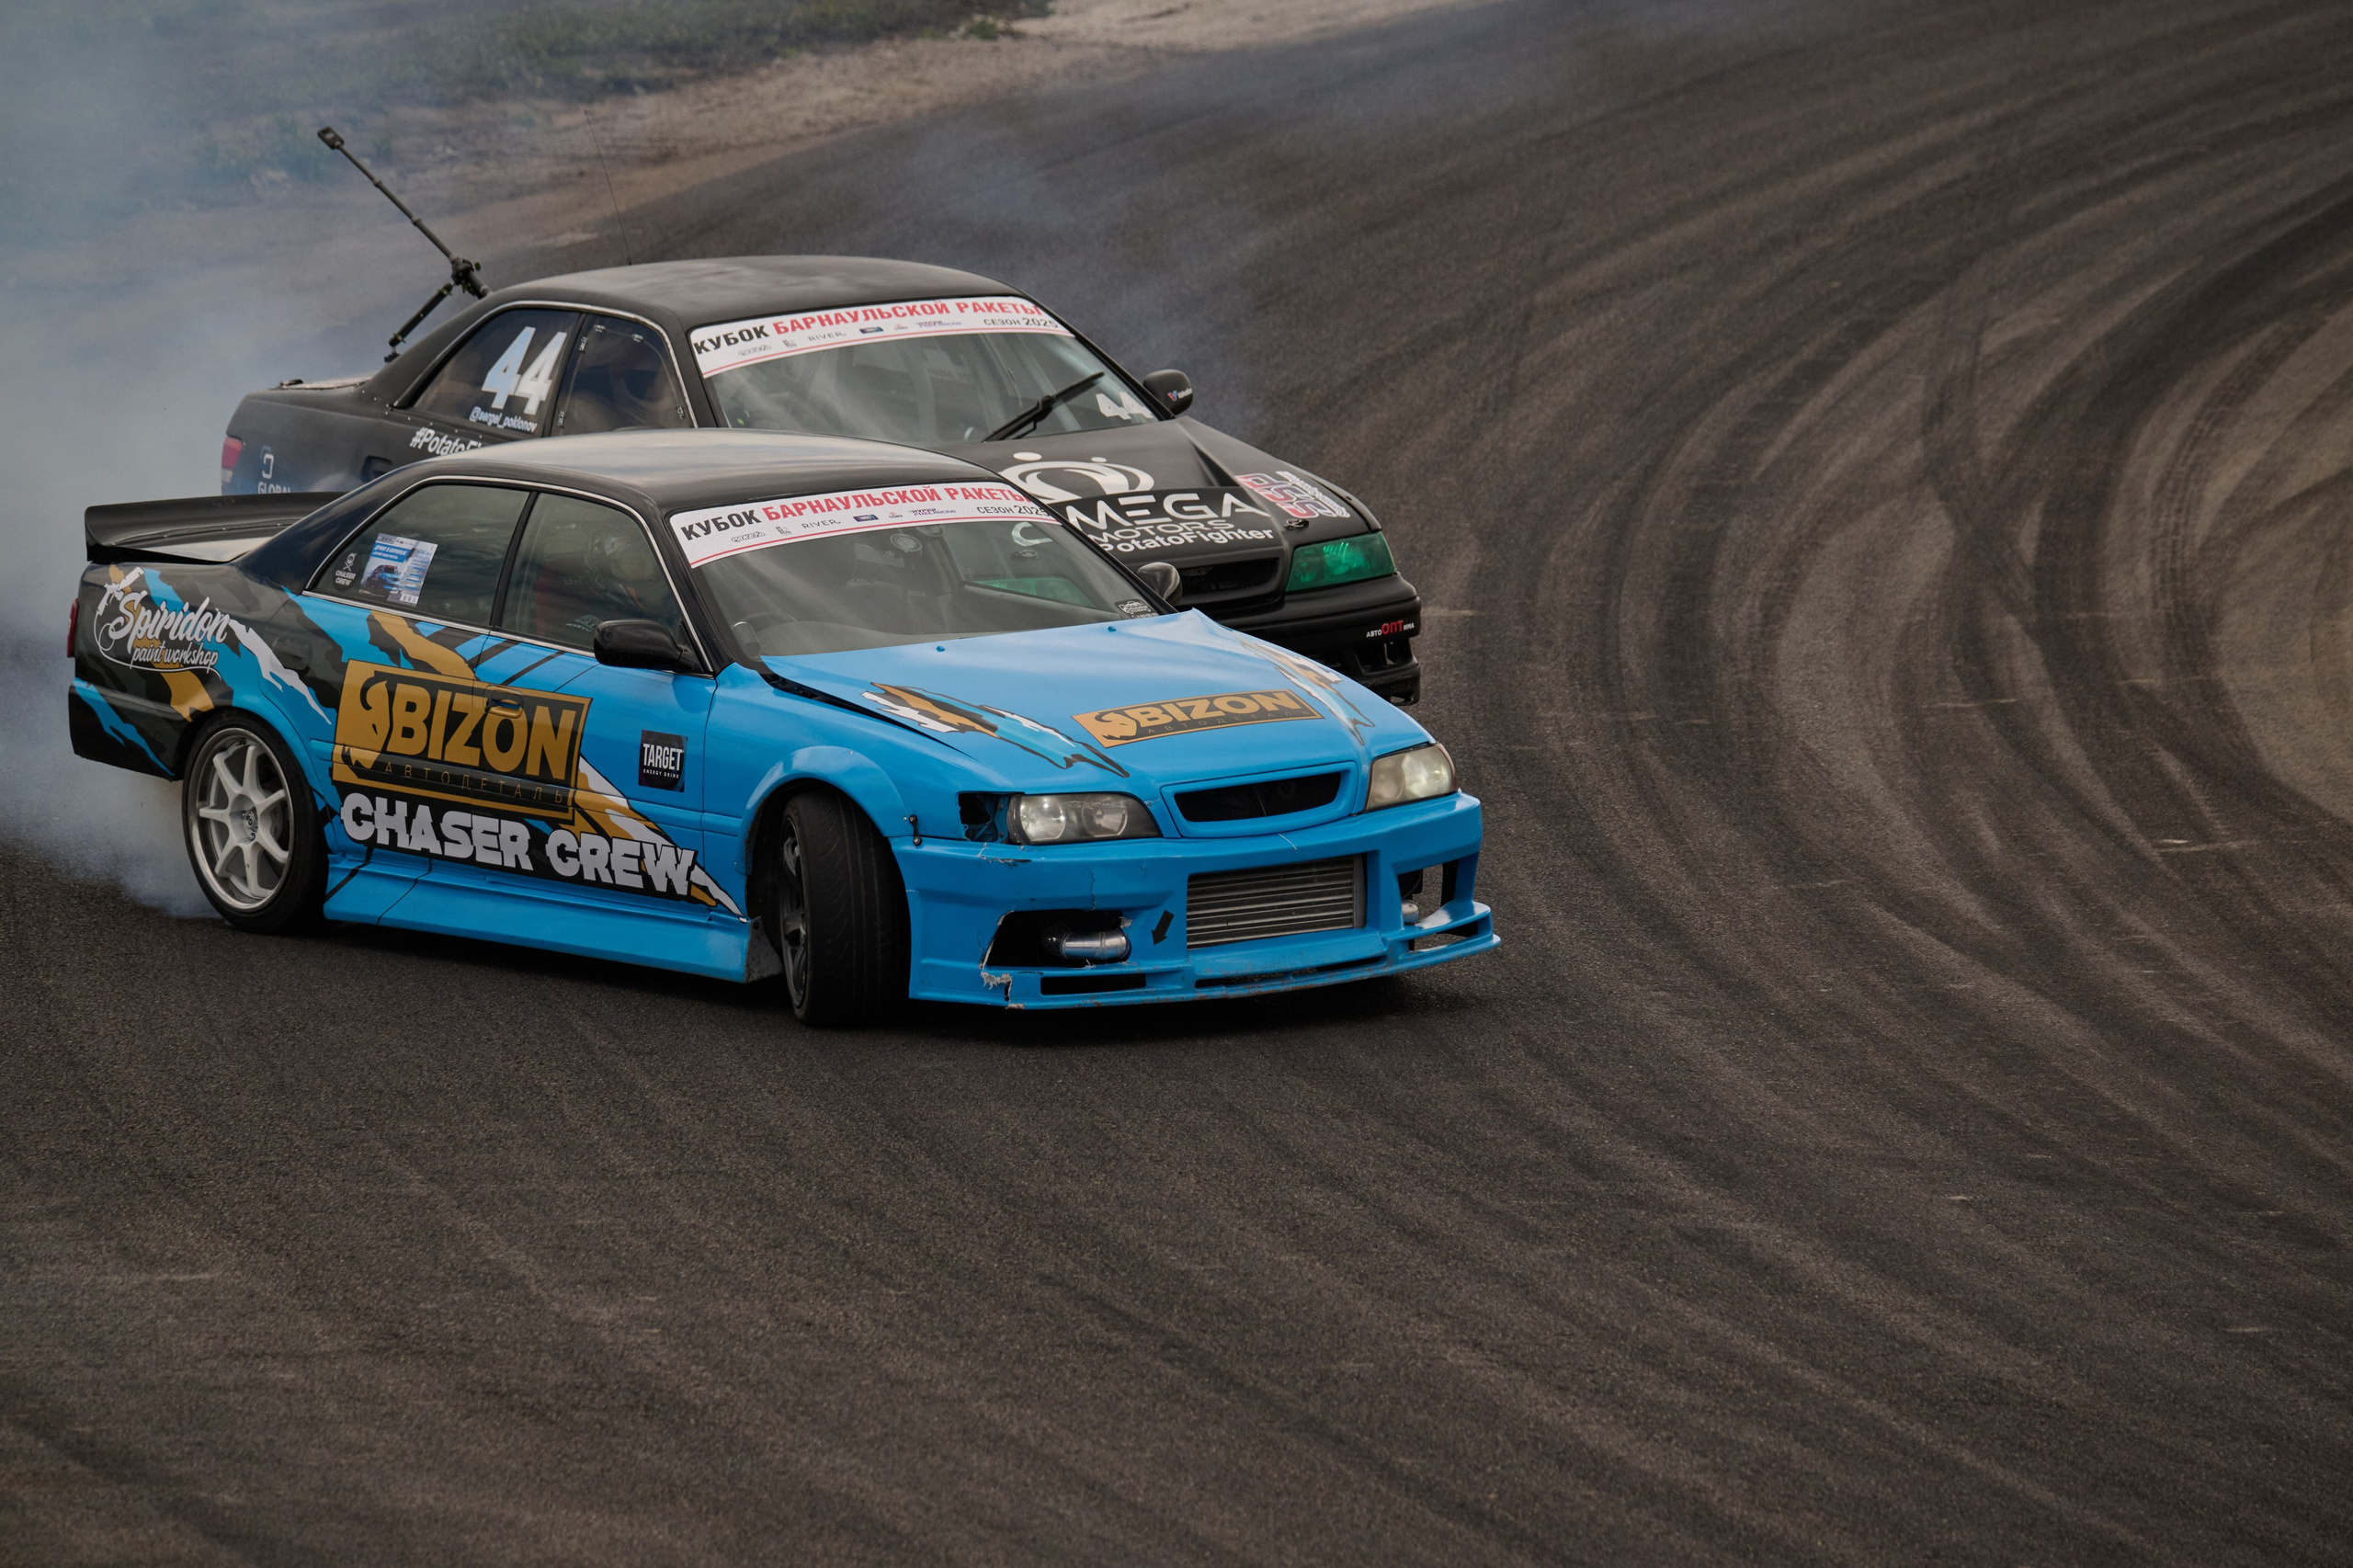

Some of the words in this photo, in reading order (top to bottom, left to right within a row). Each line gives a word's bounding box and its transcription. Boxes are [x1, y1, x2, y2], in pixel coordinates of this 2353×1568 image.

[694, 324, 770, 356] КУБОК
[772, 300, 950, 335] БАРНАУЛЬСКОЙ
[954, 301, 1043, 316] РАКЕТЫ
[983, 318, 1021, 326] СЕЗОН
[1021, 317, 1059, 329] 2025
[481, 325, 568, 416] 44
[1095, 391, 1154, 421] 44
[680, 509, 762, 541] КУБОК
[762, 485, 942, 521] БАРНАУЛЬСКОЙ
[801, 518, 841, 530] RIVER
[976, 506, 1014, 515] СЕЗОН
[1065, 492, 1271, 533] MEGA
[1087, 519, 1235, 543] MOTORS
[1098, 527, 1274, 552] PotatoFighter
[108, 589, 230, 654] Spiridon
[129, 640, 166, 670] paint
[164, 641, 220, 675] workshop
[1125, 691, 1303, 729] BIZON
[1148, 710, 1313, 734] АВТОДЕТАЛЬ
[386, 682, 577, 780] BIZON
[642, 743, 684, 771] TARGET
[642, 767, 662, 777] ENERGY
[663, 771, 679, 779] DRINK
[384, 761, 563, 804] АВТОДЕТАЛЬ
[339, 791, 535, 871] CHASER
[546, 828, 696, 896] CREW
